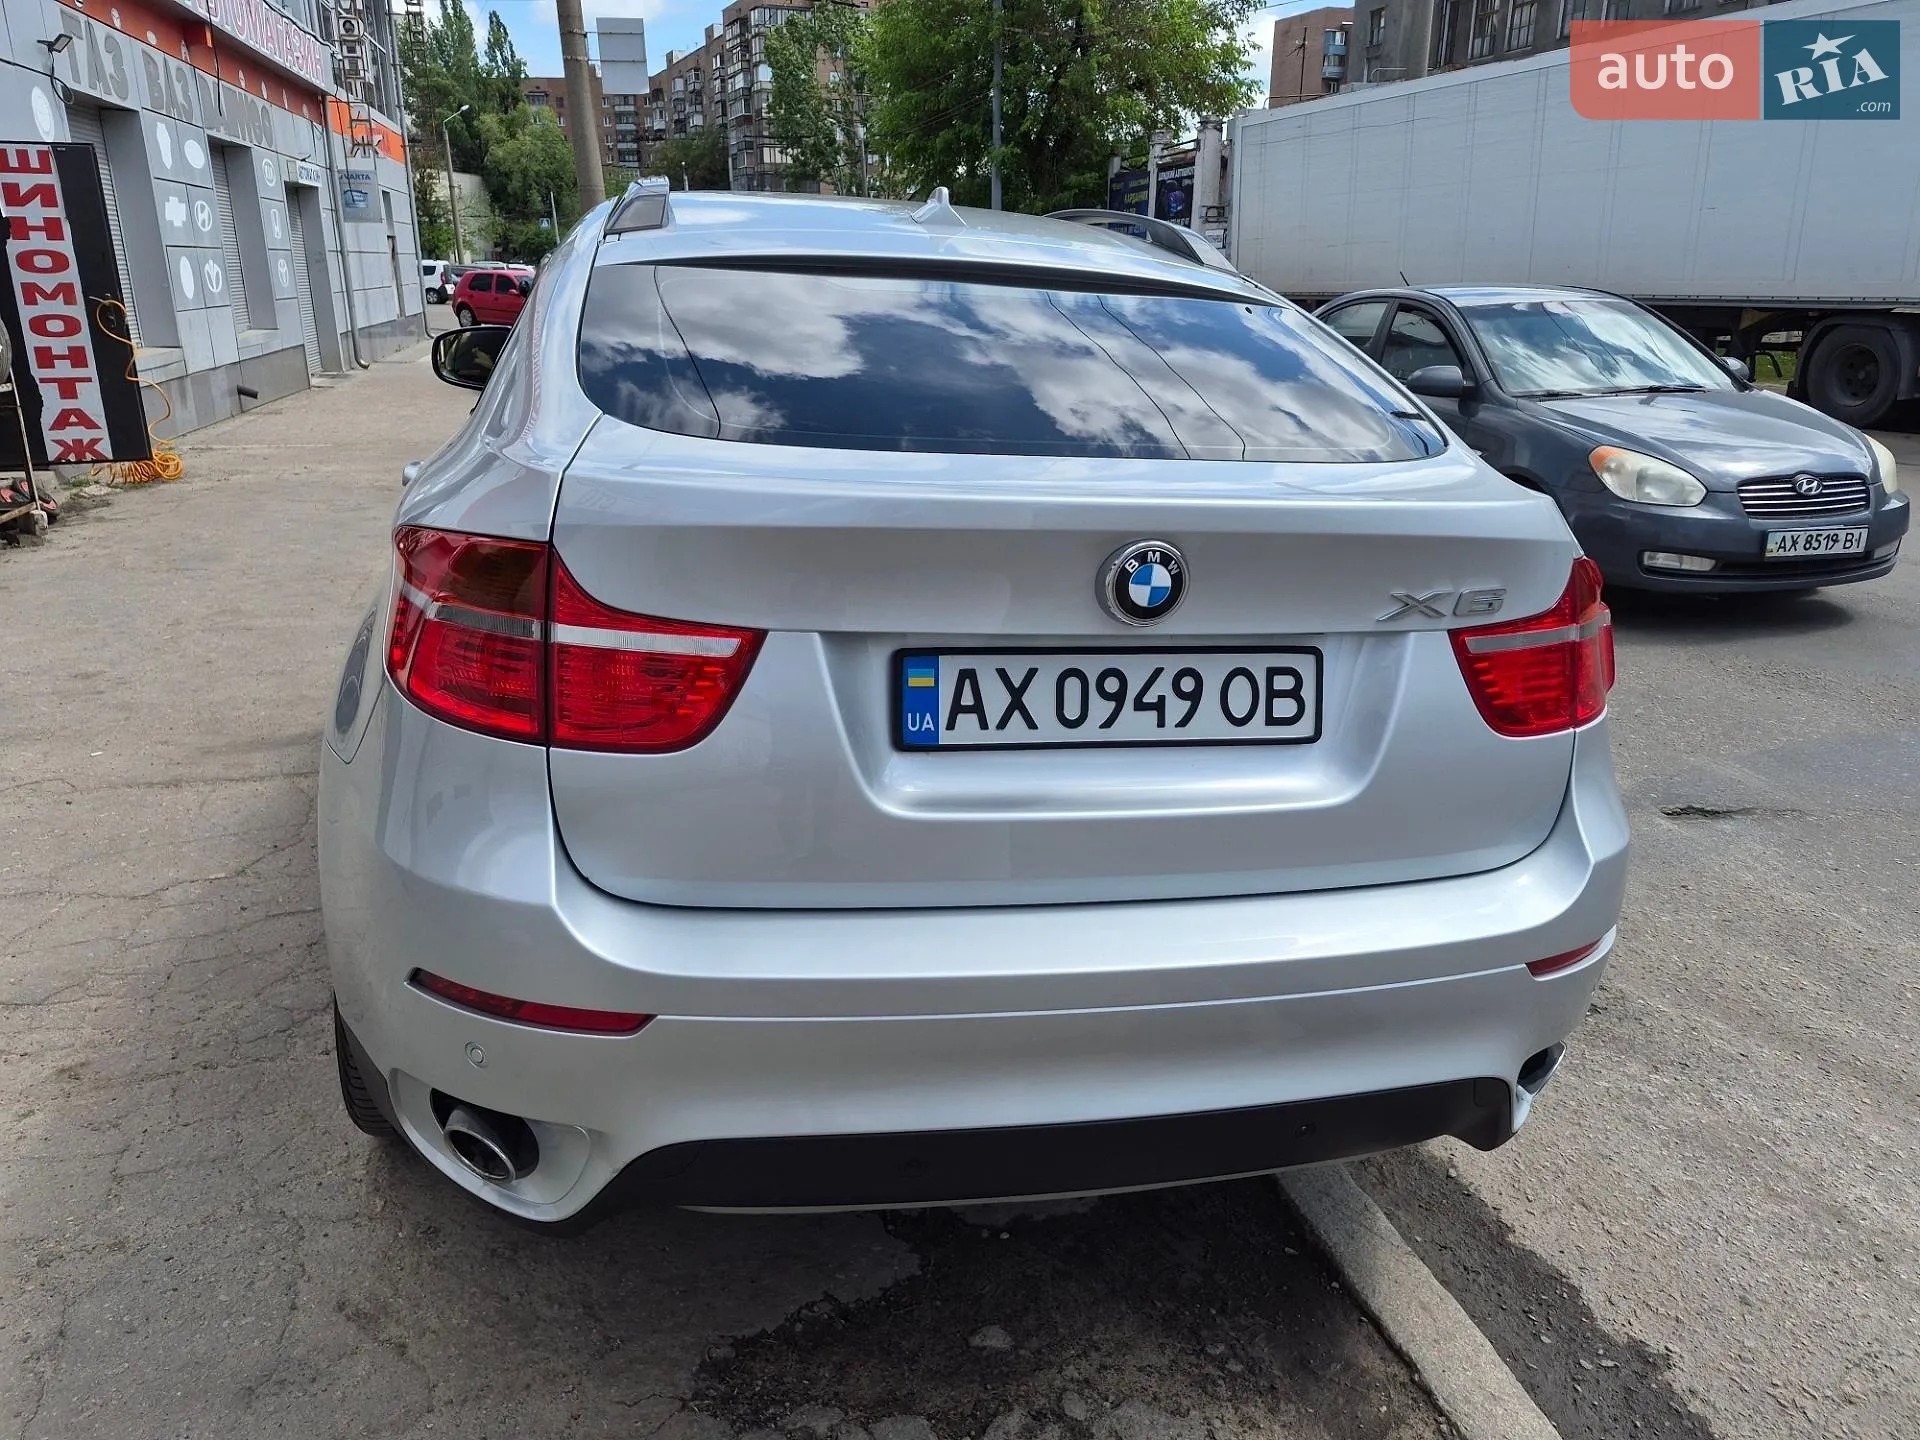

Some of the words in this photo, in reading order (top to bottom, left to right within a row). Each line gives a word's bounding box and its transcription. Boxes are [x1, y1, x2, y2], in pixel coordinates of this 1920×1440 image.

[60, 8, 129, 101] ГАЗ
[141, 50, 194, 122] ВАЗ
[0, 148, 108, 462] ШИНОМОНТАЖ
[1776, 536, 1800, 553] AX
[1803, 533, 1839, 551] 8519
[1124, 551, 1180, 575] BMW
[1376, 585, 1507, 622] X6
[945, 668, 1039, 730] AX
[1055, 667, 1204, 729] 0949
[1219, 666, 1306, 727] OB
[907, 712, 935, 731] UA
